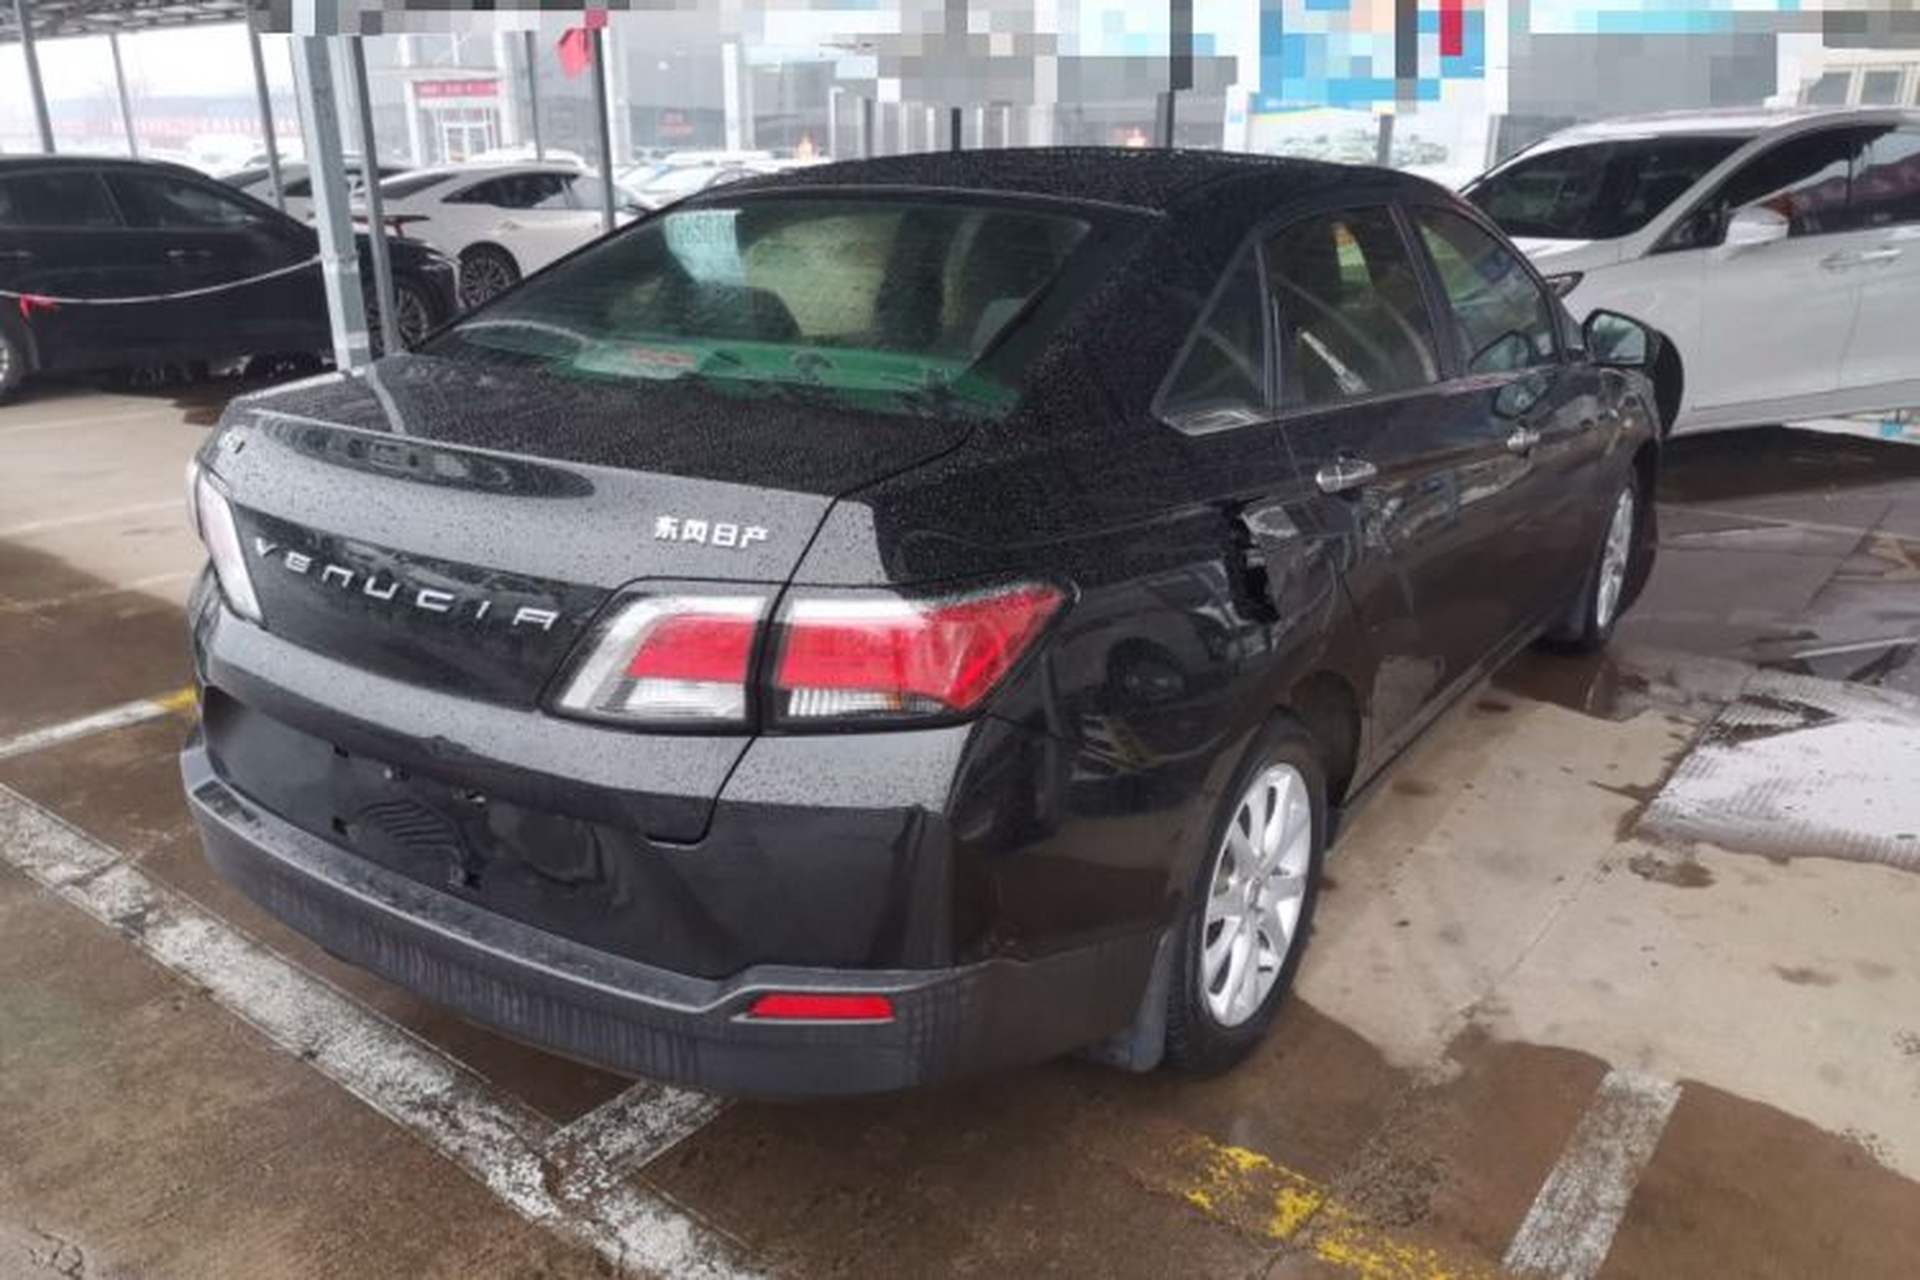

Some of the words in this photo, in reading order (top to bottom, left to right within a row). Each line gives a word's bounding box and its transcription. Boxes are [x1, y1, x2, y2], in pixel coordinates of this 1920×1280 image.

[654, 516, 769, 549] 东风日产
[255, 536, 560, 631] VENUCIA
